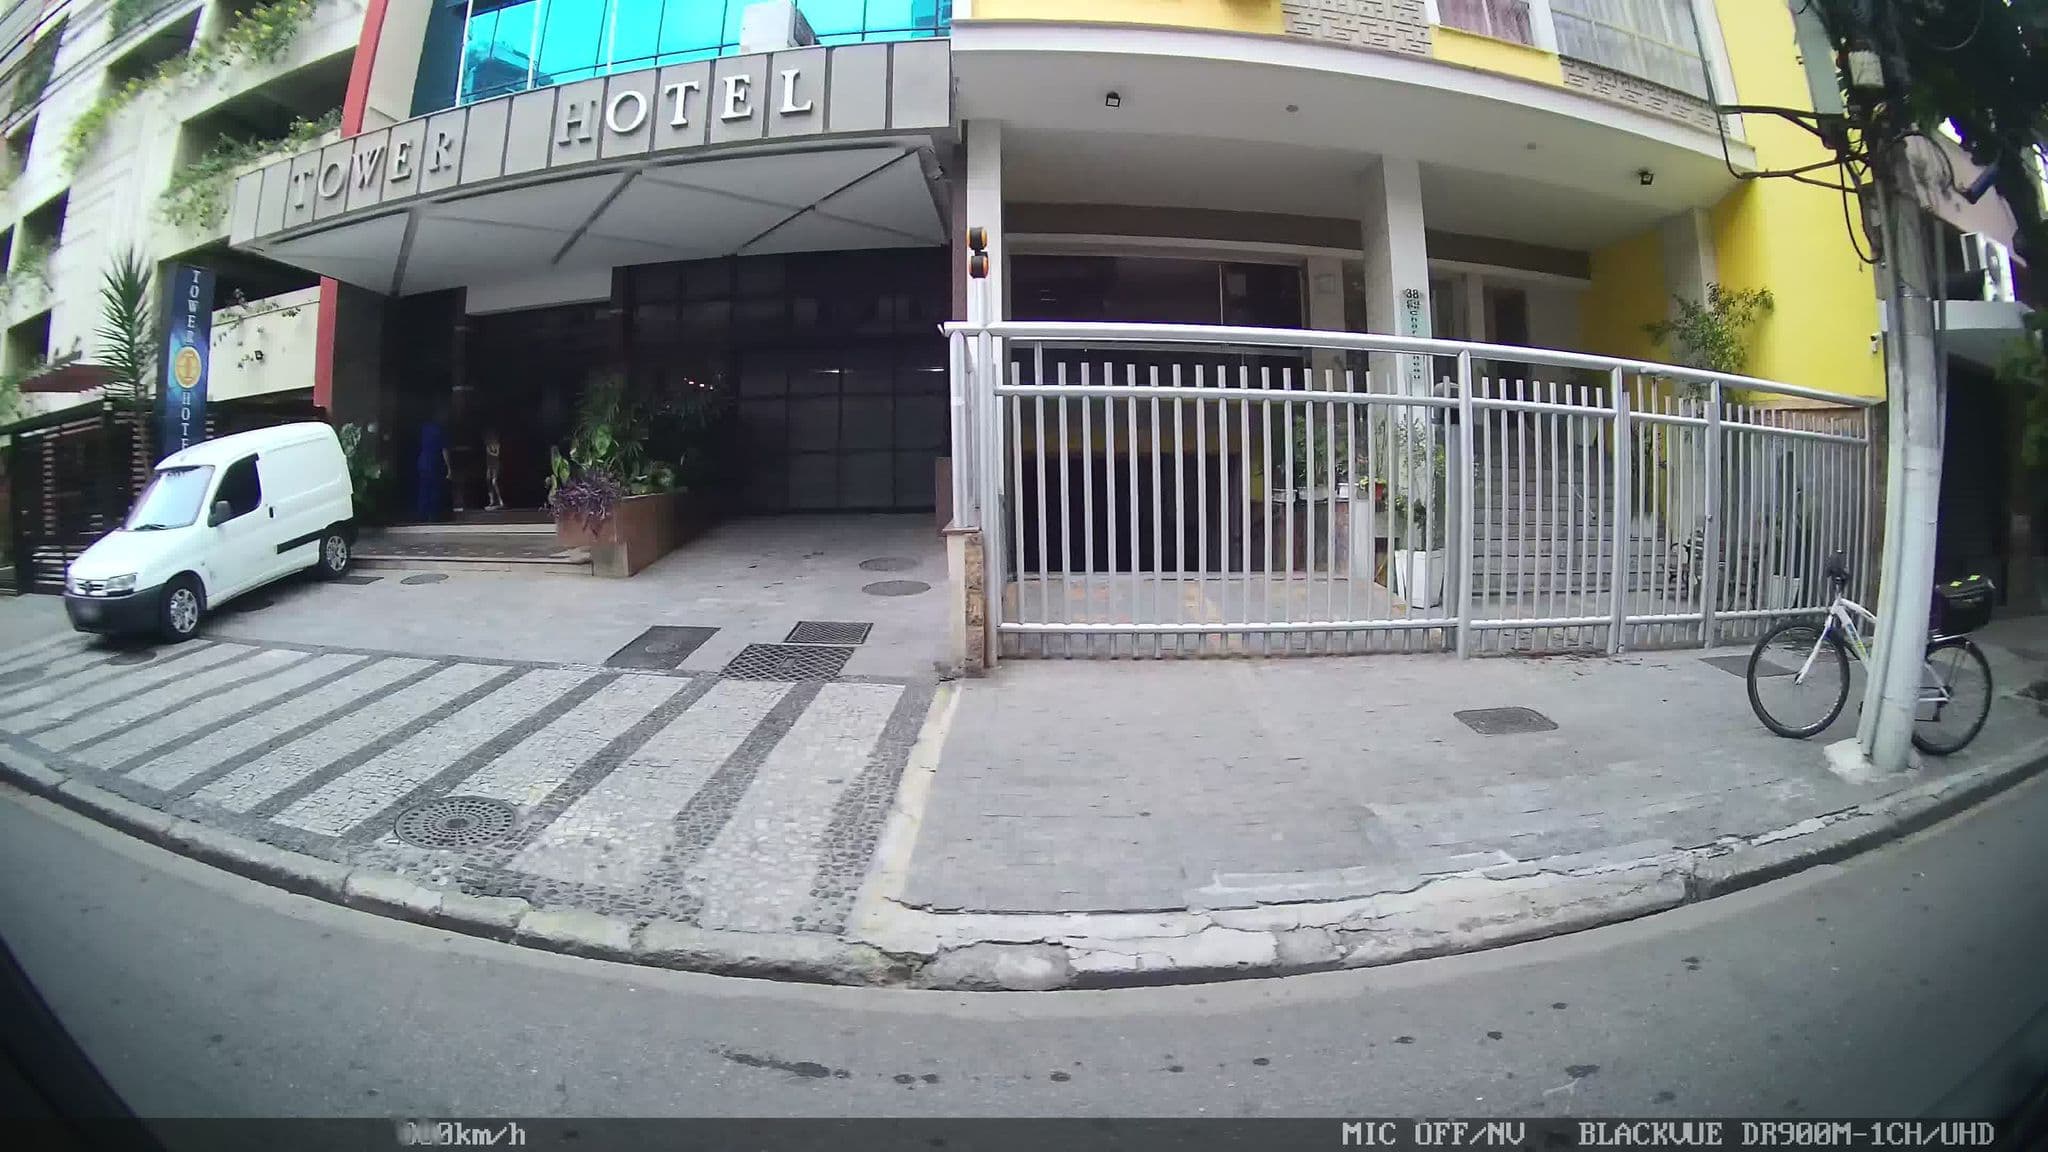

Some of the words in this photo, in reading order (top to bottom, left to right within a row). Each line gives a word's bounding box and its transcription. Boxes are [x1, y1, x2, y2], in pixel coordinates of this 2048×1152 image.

[293, 131, 454, 208] TOWER
[557, 68, 814, 146] HOTEL
[185, 270, 200, 345] TOWER
